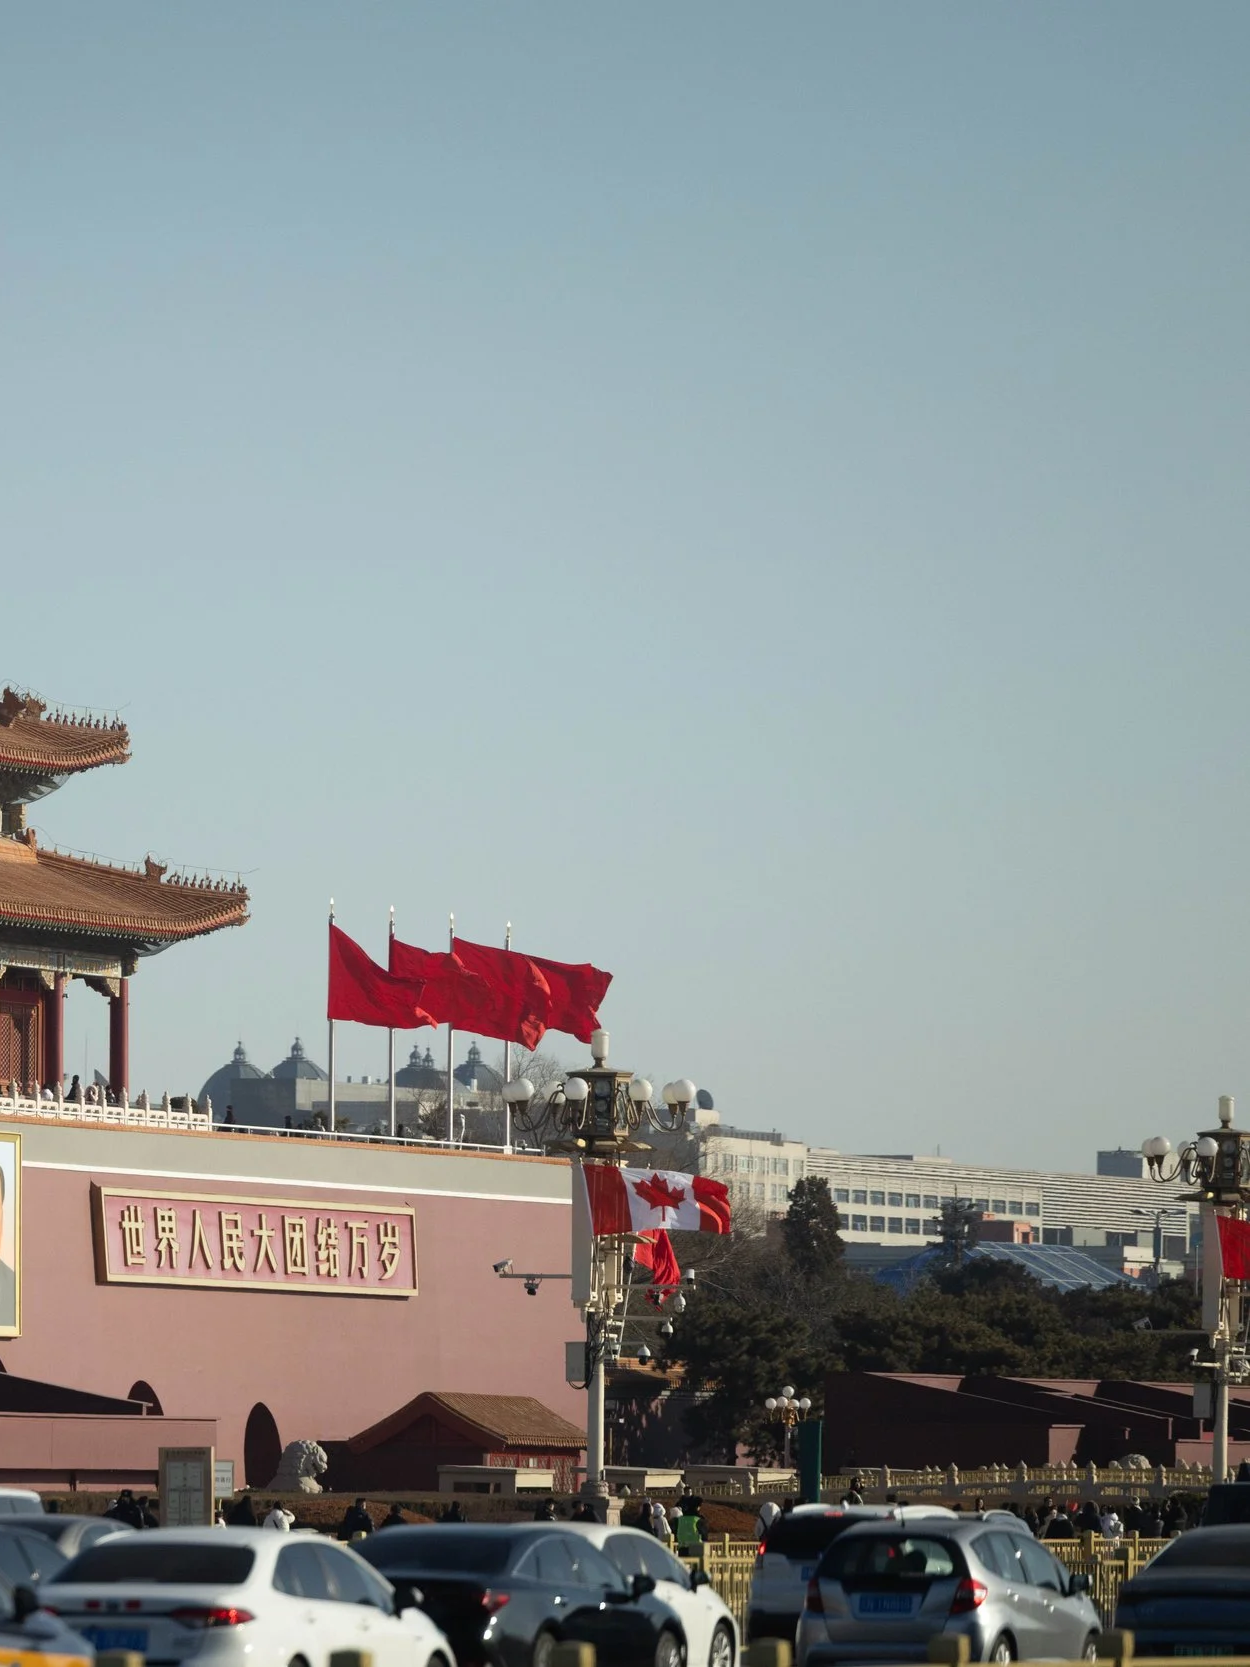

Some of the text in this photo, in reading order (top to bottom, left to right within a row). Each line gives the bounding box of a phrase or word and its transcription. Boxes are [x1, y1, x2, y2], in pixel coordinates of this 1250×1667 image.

[119, 1204, 401, 1281] 世界人民大团结万岁
